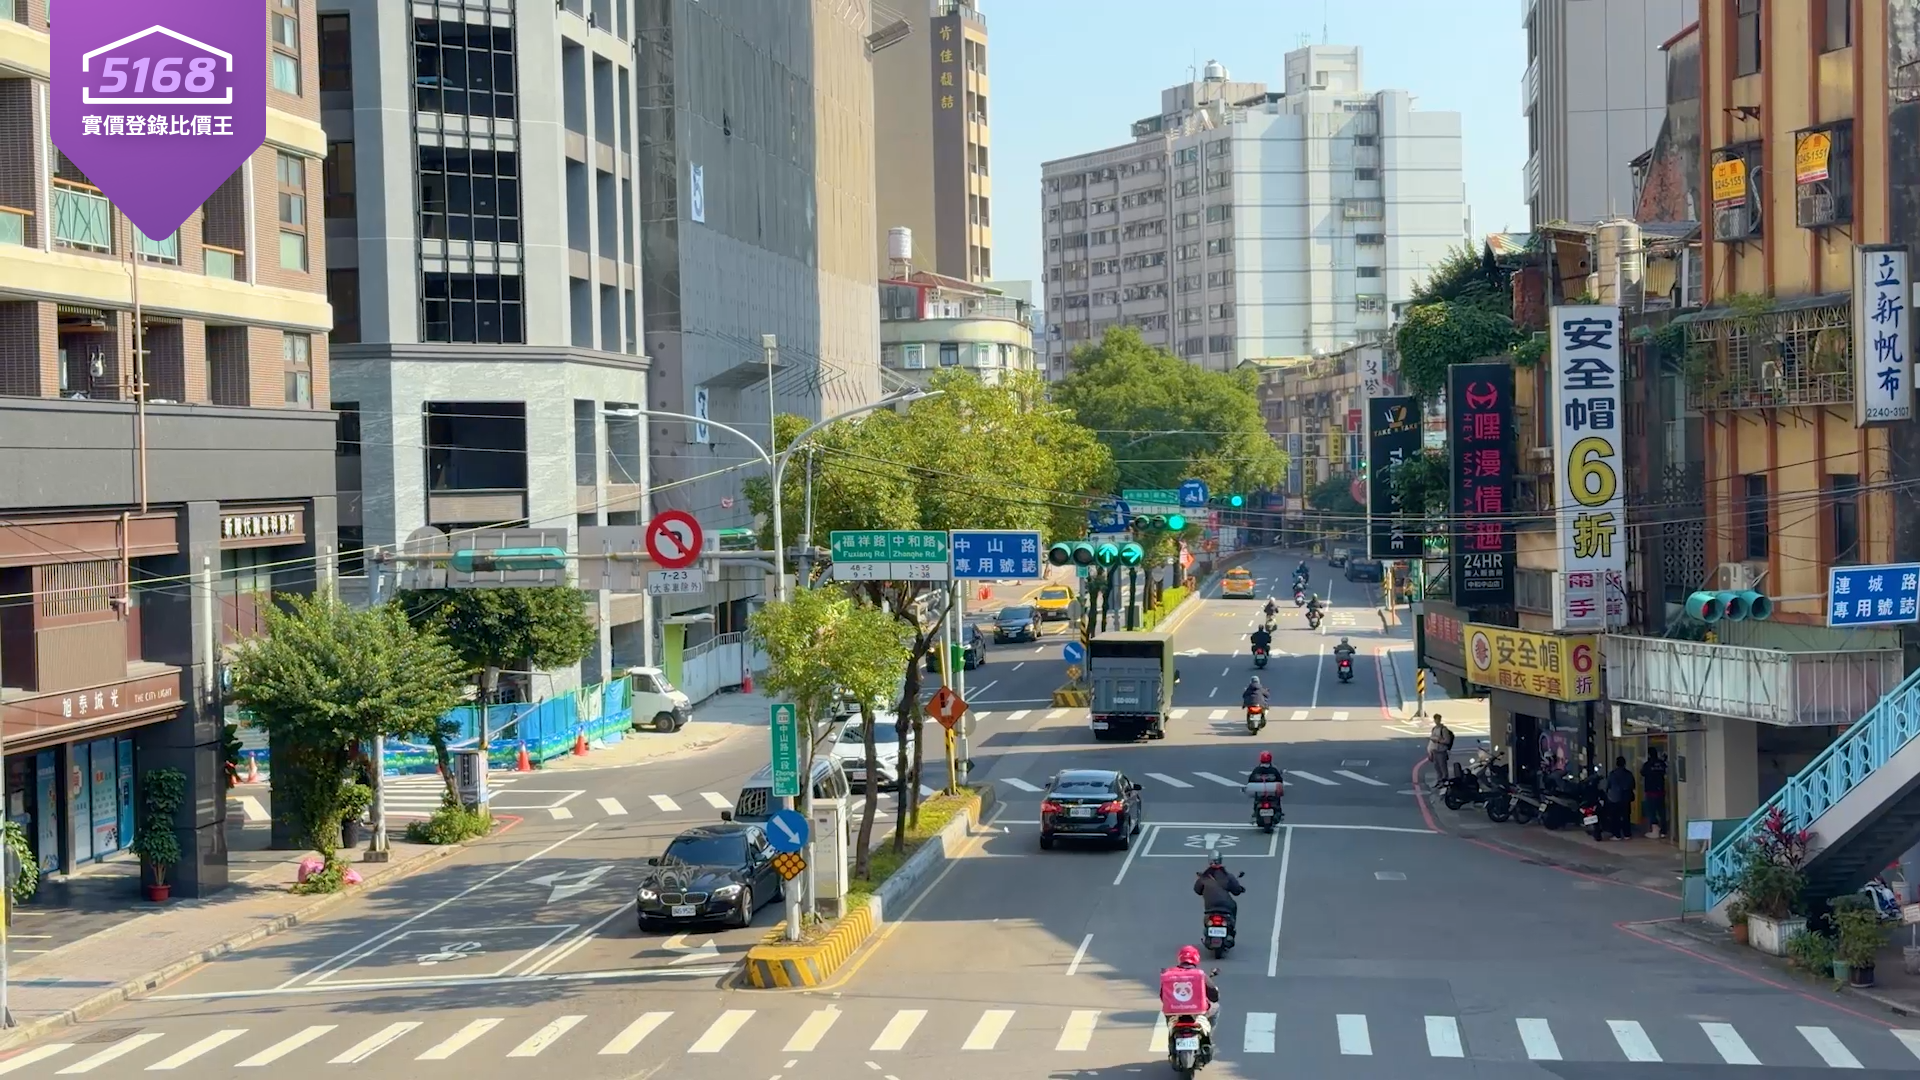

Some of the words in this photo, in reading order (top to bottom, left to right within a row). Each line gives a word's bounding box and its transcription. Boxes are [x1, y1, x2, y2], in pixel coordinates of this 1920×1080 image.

[1871, 254, 1904, 401] 立新帆布
[1867, 406, 1909, 418] 2240-3107
[1463, 413, 1473, 442] HEY
[1463, 452, 1473, 488] MAN
[1475, 413, 1502, 550] 嘿漫情趣
[842, 535, 886, 548] 福祥路
[893, 535, 936, 548] 中和路
[955, 538, 1036, 553] 中山路
[843, 551, 872, 559] Fuxiang
[892, 551, 924, 559] Zhonghe
[1464, 554, 1504, 569] 24HR
[955, 557, 1037, 573] 專用號誌
[661, 571, 688, 580] 7-23
[1834, 573, 1917, 595] 連城路
[1833, 596, 1916, 619] 專用號誌
[1496, 634, 1559, 673] 安全帽
[1499, 667, 1527, 690] 雨衣
[1532, 673, 1562, 696] 手套
[135, 694, 144, 703] THE
[779, 725, 790, 770] 中山路二段
